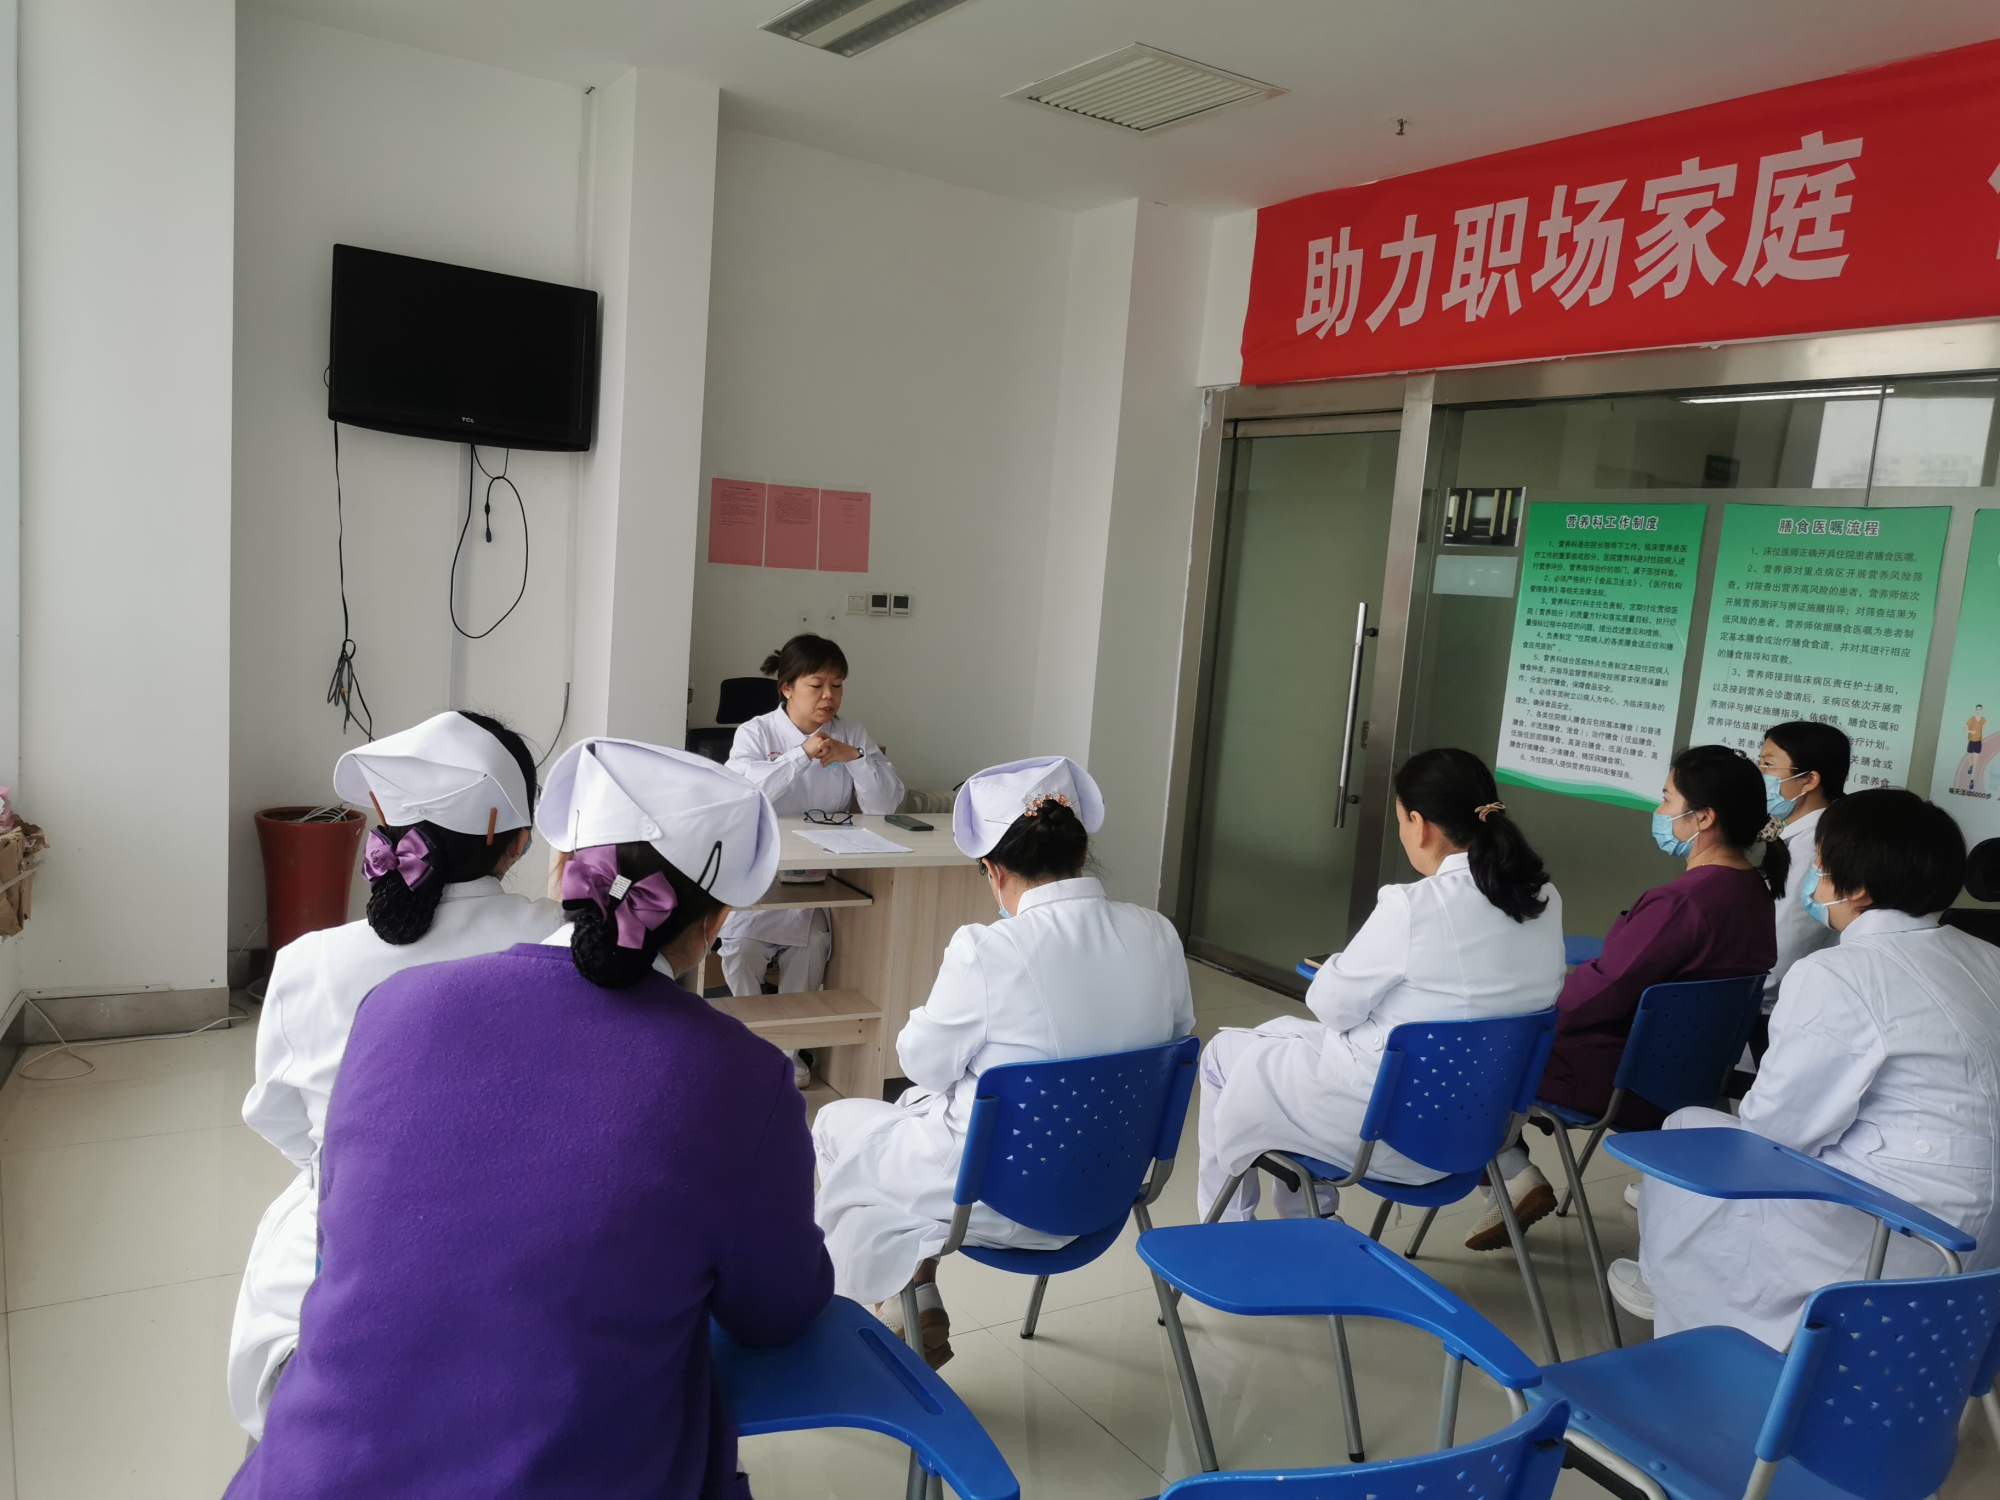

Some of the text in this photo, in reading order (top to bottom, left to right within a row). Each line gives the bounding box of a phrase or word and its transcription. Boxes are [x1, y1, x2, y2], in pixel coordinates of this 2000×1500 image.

[1295, 131, 1864, 340] 助力职场家庭
[461, 416, 475, 424] TCL
[1566, 514, 1659, 531] 营养科工作制度
[1777, 517, 1881, 537] 膳食医嘱流程
